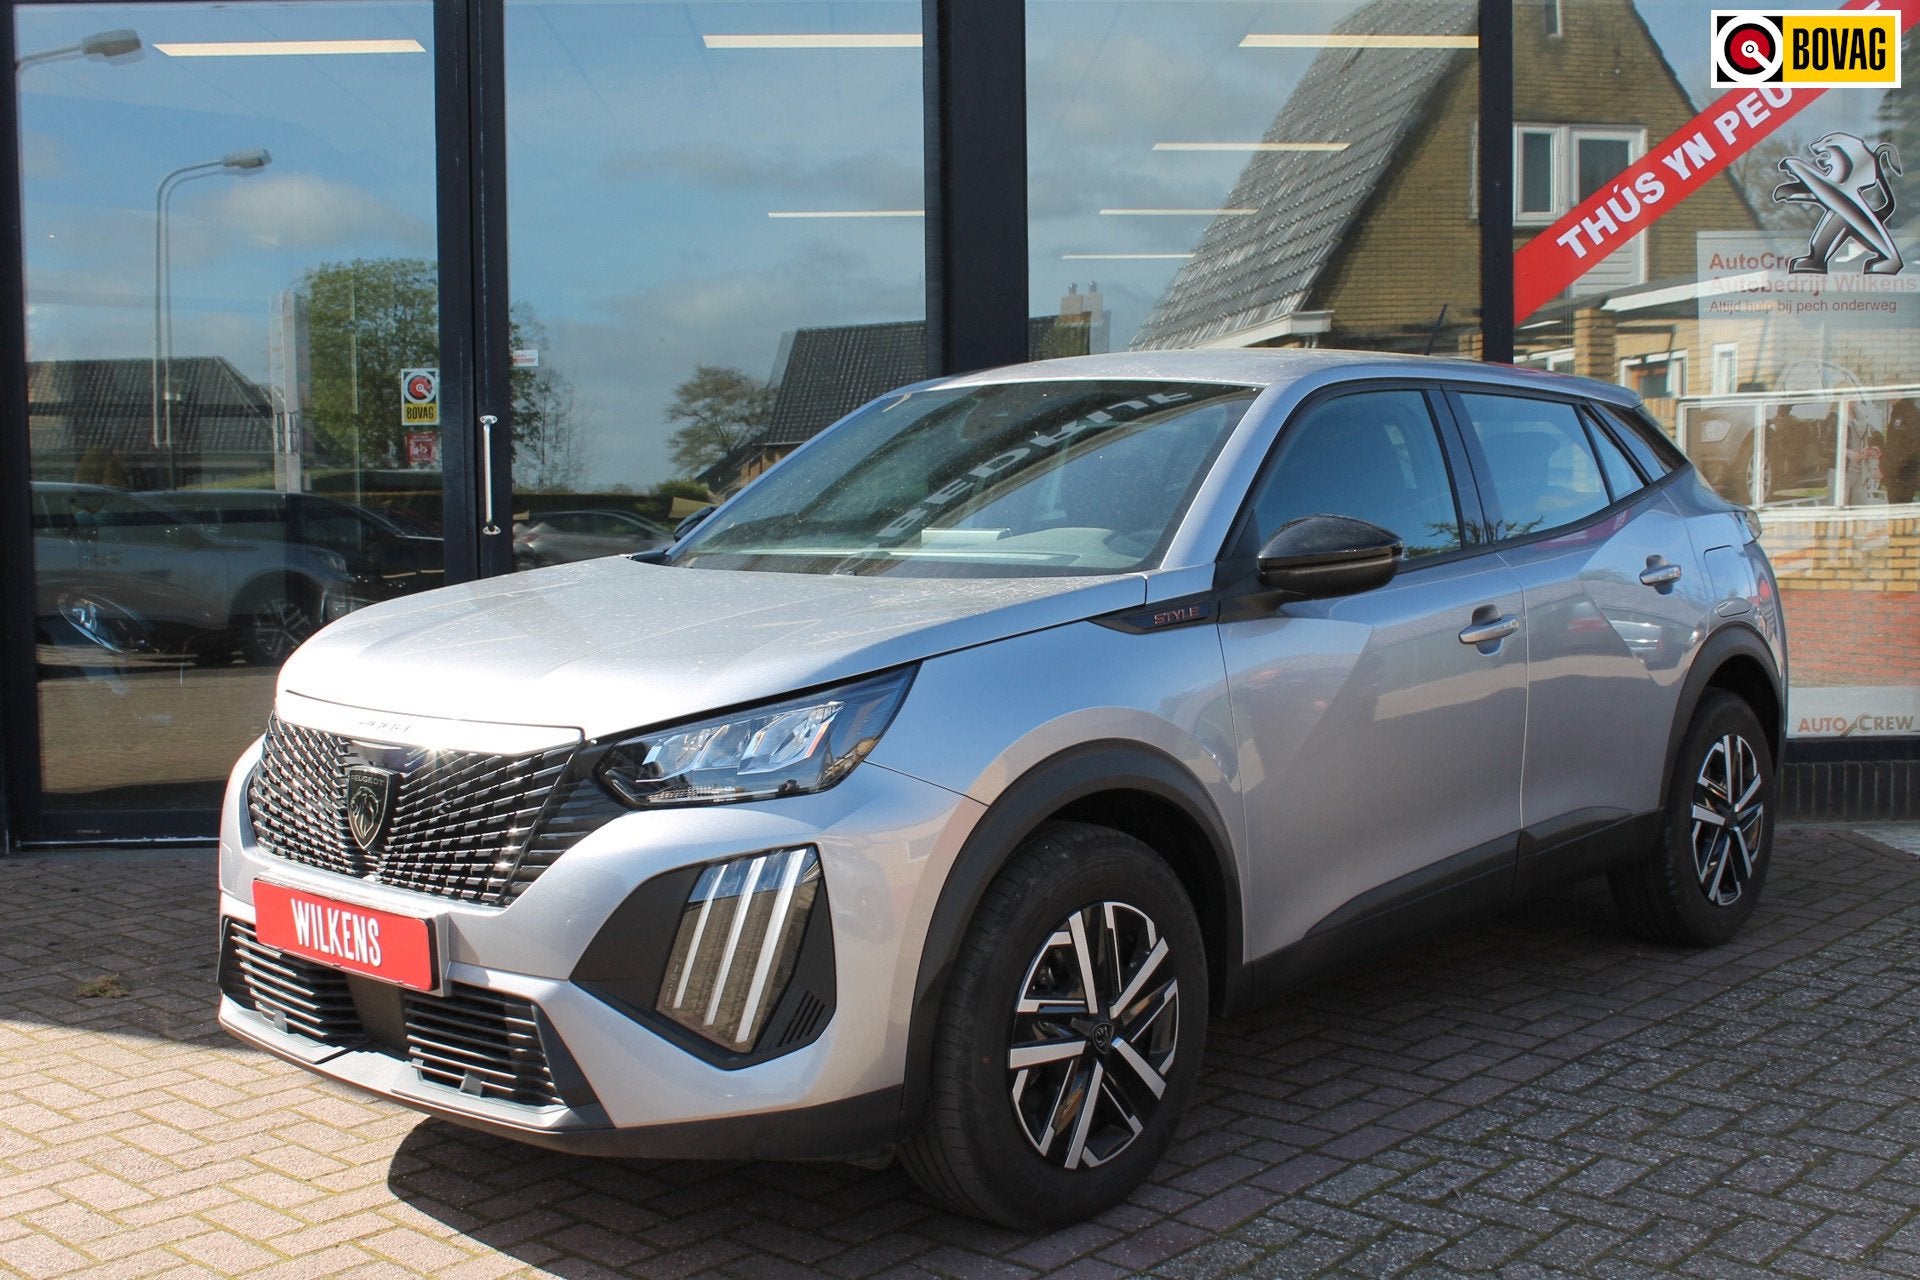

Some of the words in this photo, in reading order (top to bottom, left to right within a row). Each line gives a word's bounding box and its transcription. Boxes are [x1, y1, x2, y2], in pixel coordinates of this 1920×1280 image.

[1556, 172, 1665, 259] THÚS
[1662, 132, 1716, 181] YN
[1834, 272, 1917, 292] Wilkens
[1709, 300, 1741, 315] Altijd
[1777, 299, 1793, 314] bij
[1796, 299, 1828, 314] pech
[1832, 299, 1897, 313] onderweg
[406, 406, 434, 420] BOVAG
[1154, 606, 1200, 625] STYLE
[351, 774, 384, 786] PEUGEOT
[290, 898, 382, 967] WILKENS
